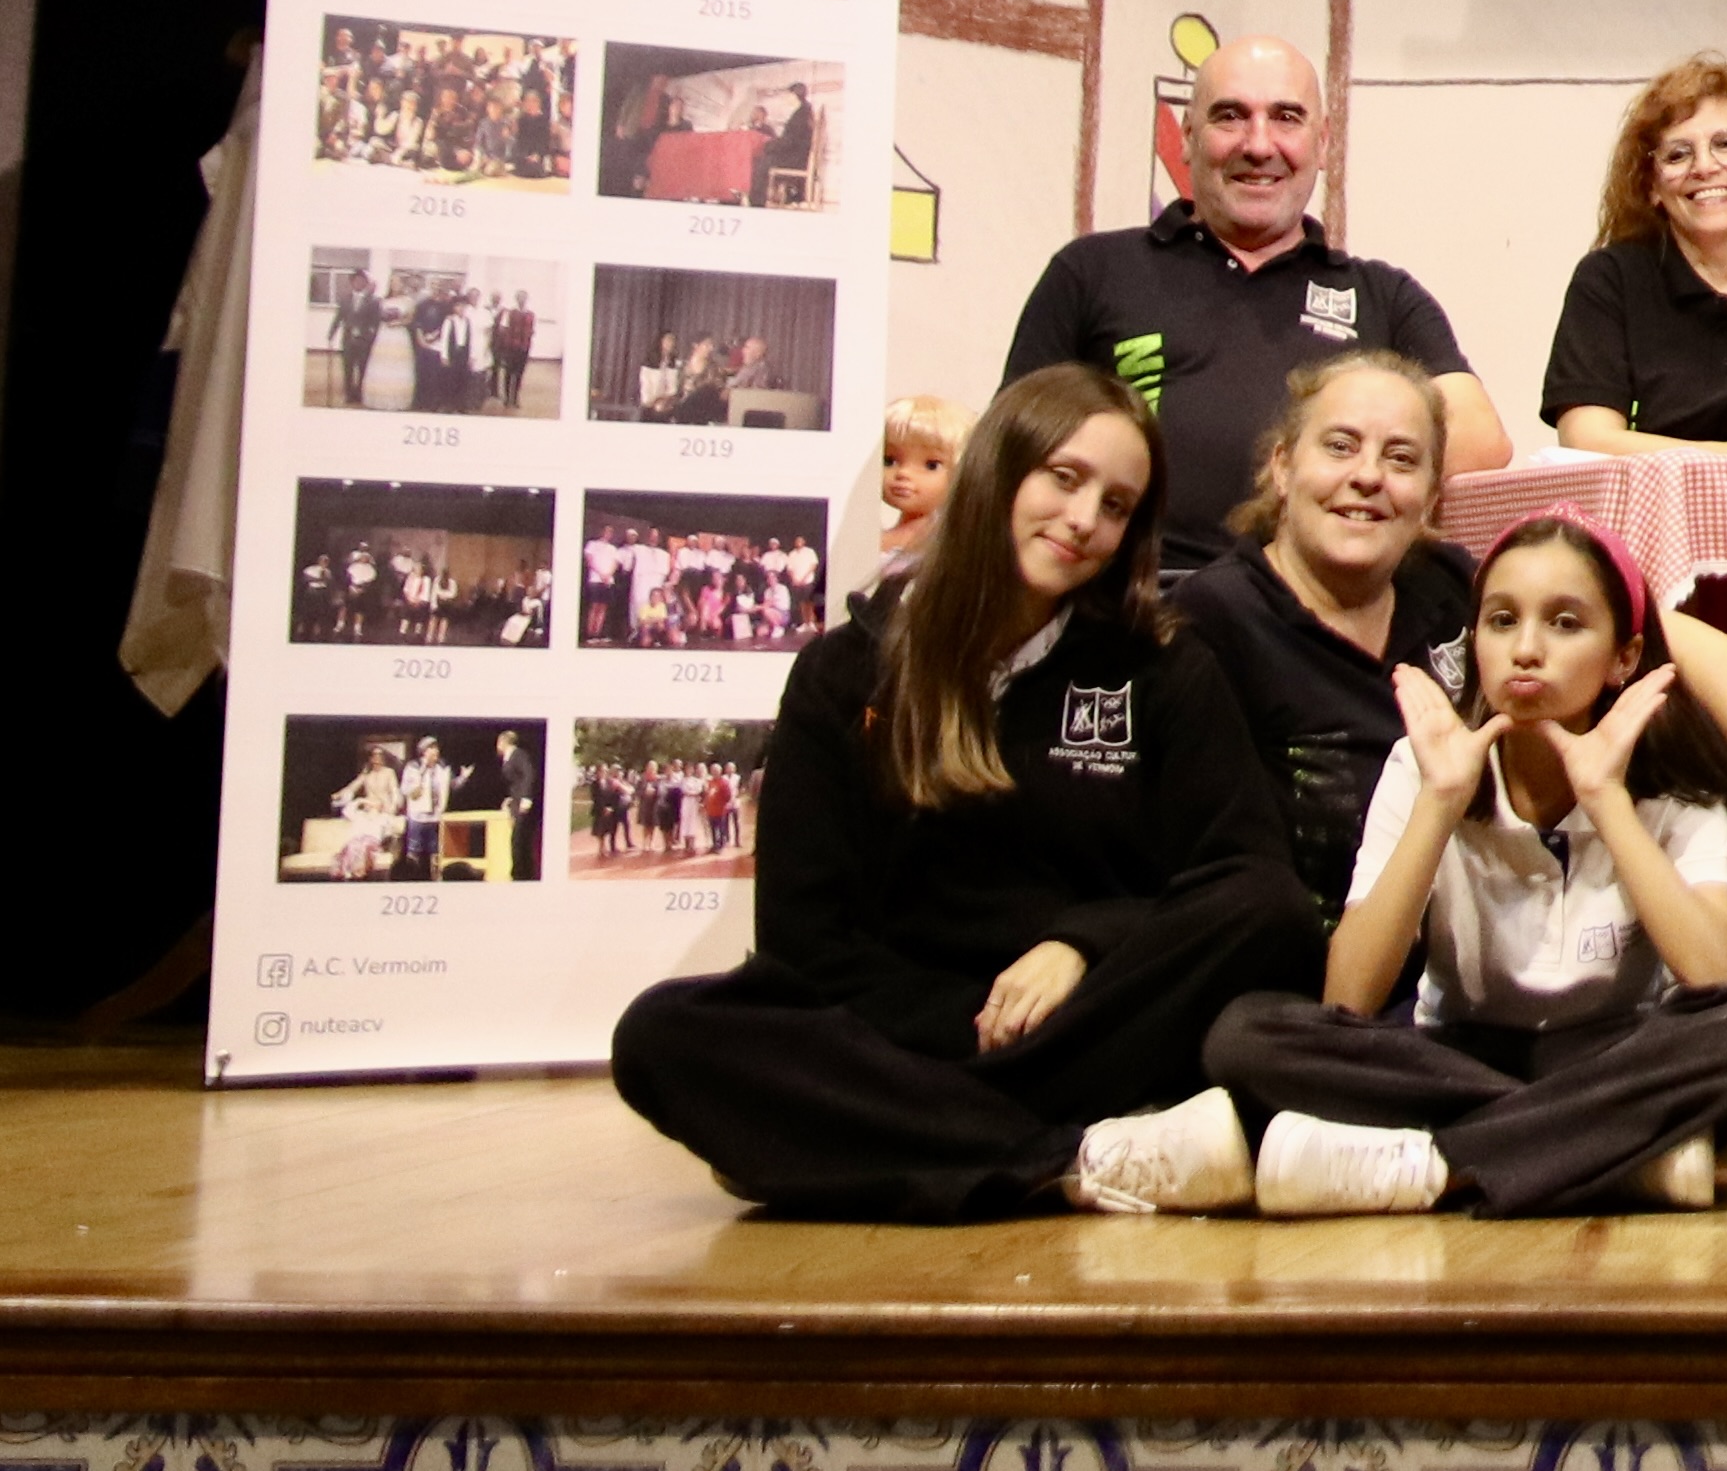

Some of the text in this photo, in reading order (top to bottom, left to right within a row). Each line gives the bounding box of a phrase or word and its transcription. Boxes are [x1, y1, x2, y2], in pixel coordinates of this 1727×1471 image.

[409, 196, 465, 219] 2016
[688, 216, 741, 237] 2017
[402, 426, 460, 448] 2018
[679, 438, 733, 458] 2019
[393, 659, 451, 680] 2020
[671, 664, 724, 683] 2021
[380, 895, 439, 916] 2022
[665, 892, 719, 911] 2023
[302, 957, 447, 976] A.C. Vermoim
[300, 1016, 383, 1034] nuteacv
